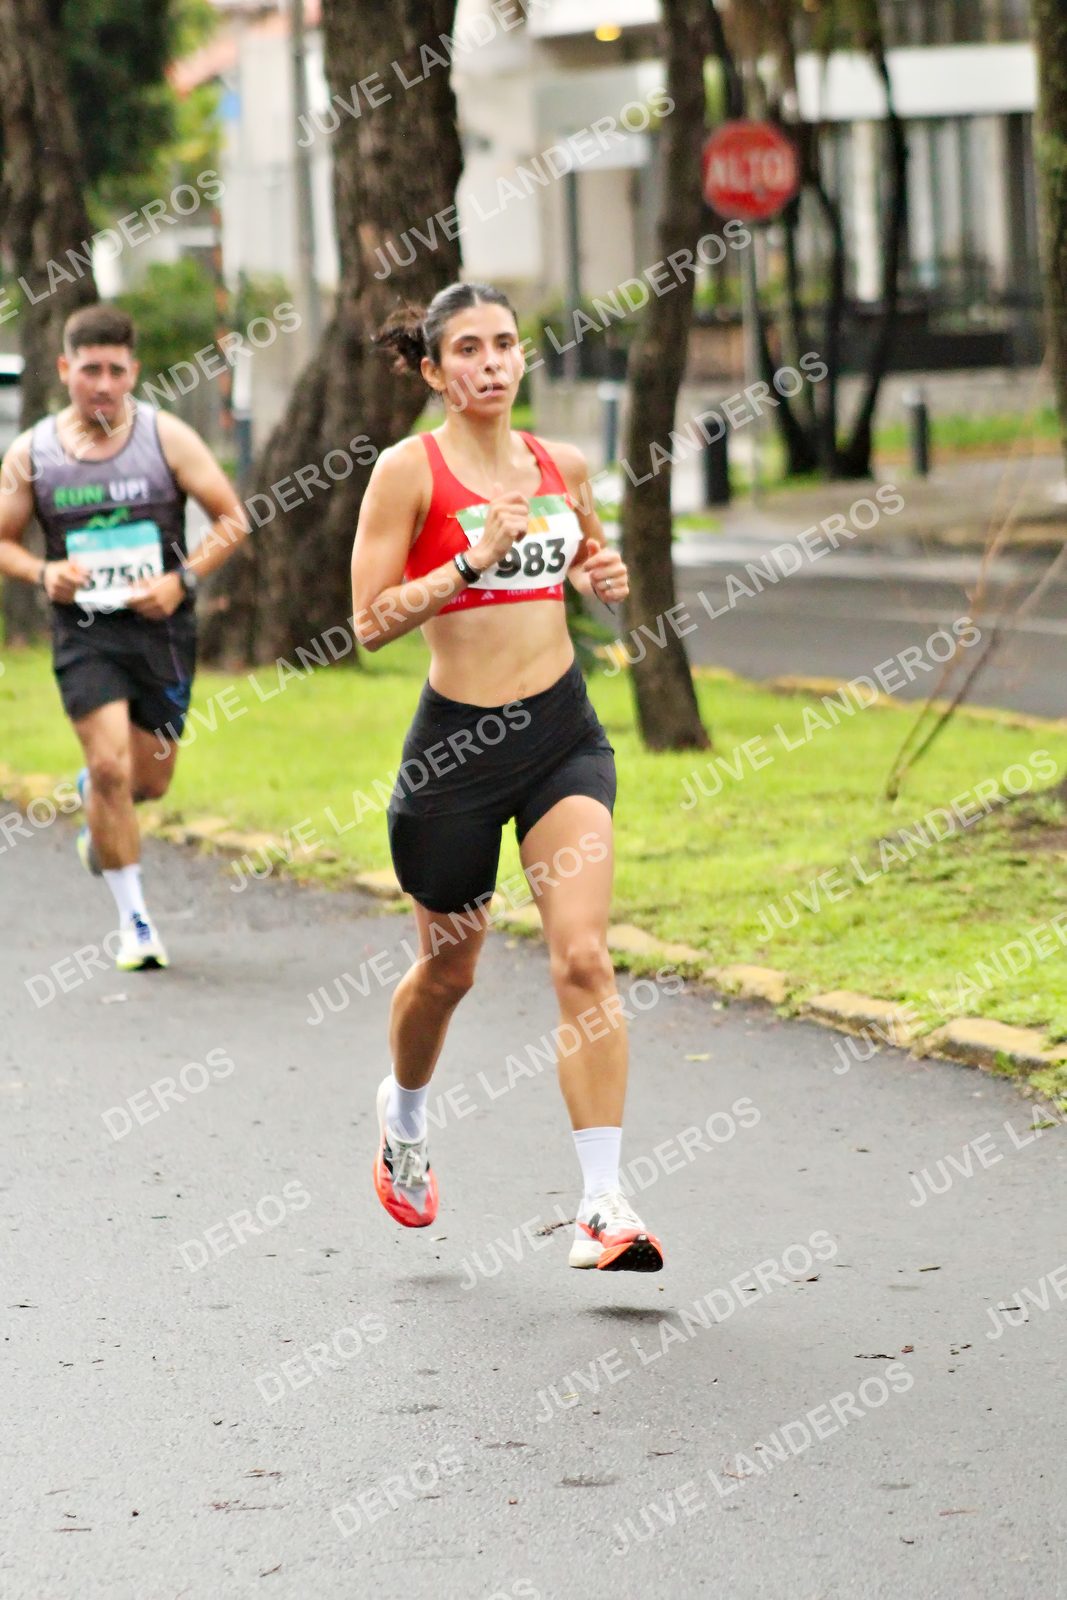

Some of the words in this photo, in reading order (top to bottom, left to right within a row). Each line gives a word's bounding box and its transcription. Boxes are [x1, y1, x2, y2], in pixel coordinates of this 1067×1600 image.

[706, 149, 786, 192] ALTO
[54, 484, 105, 509] RUN
[495, 537, 566, 579] 983
